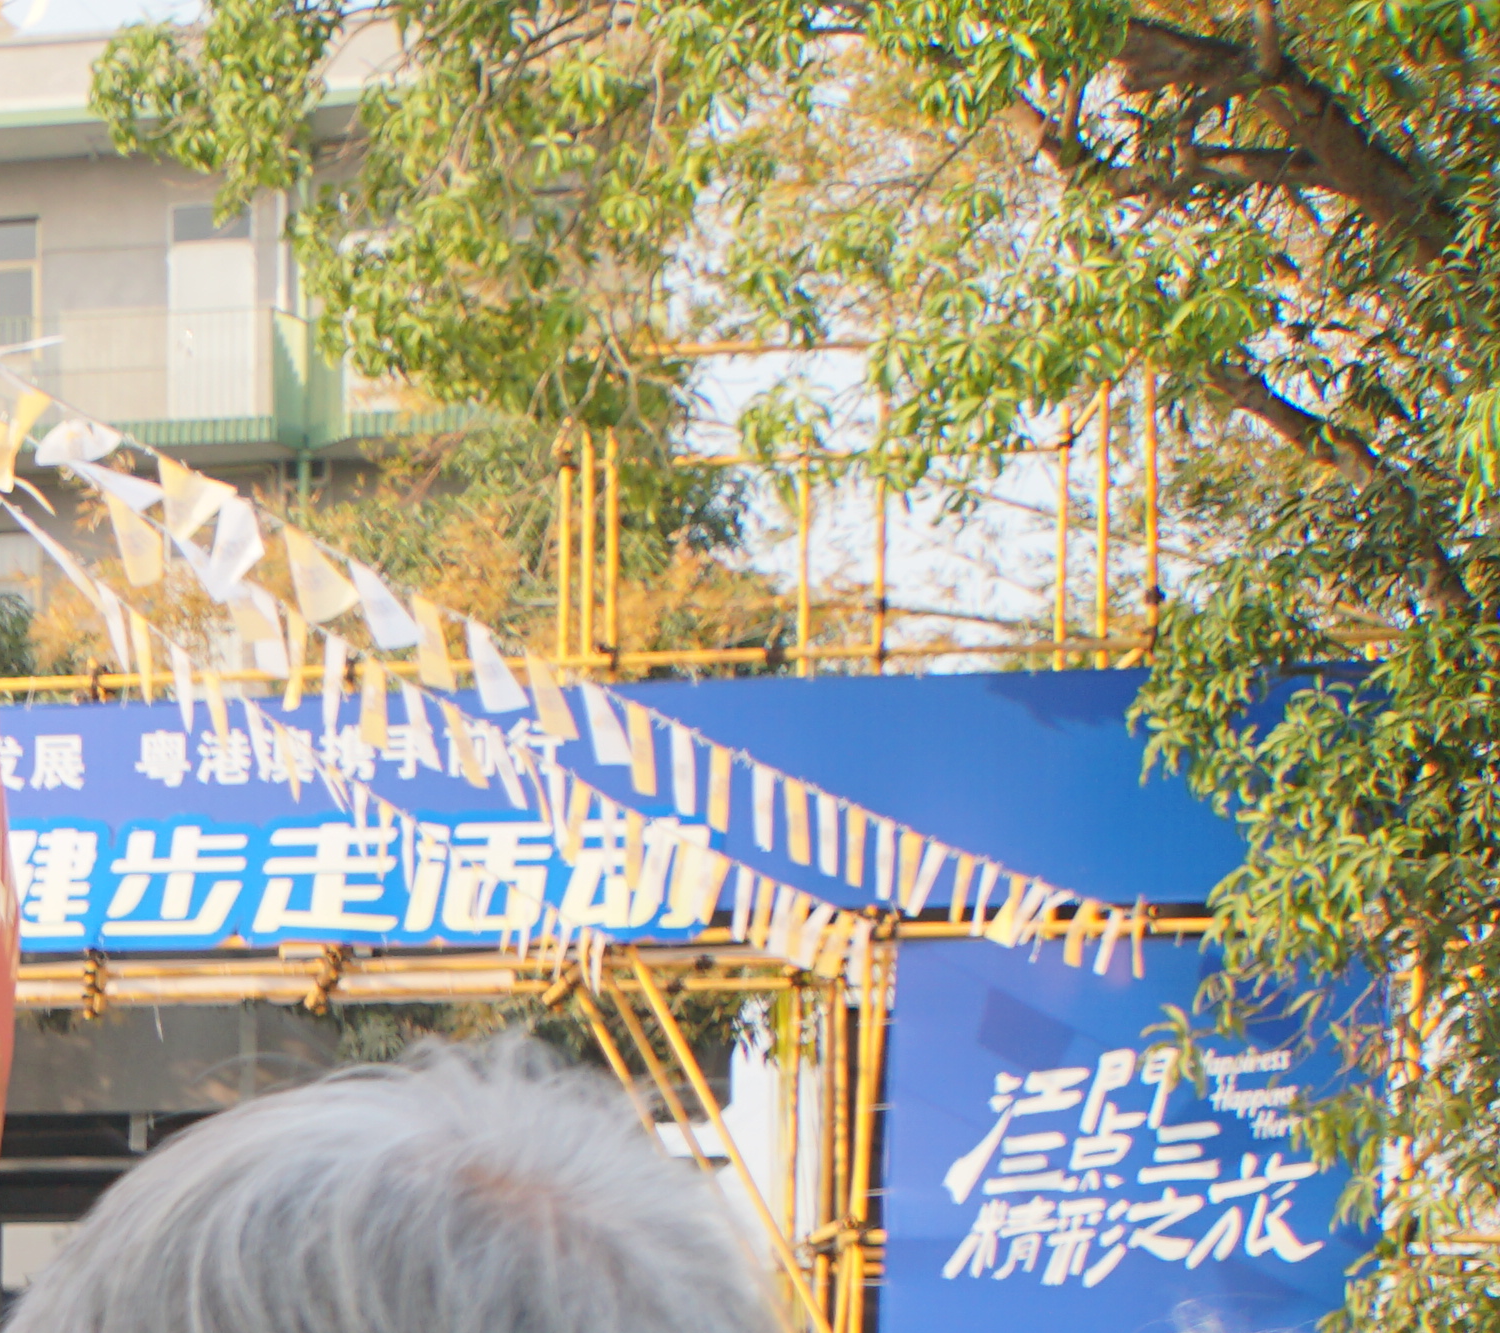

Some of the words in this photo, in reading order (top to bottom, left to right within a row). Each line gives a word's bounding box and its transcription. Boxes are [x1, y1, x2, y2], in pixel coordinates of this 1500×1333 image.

[1249, 1110, 1302, 1140] Her
[942, 1153, 1325, 1288] 精彩之旅
